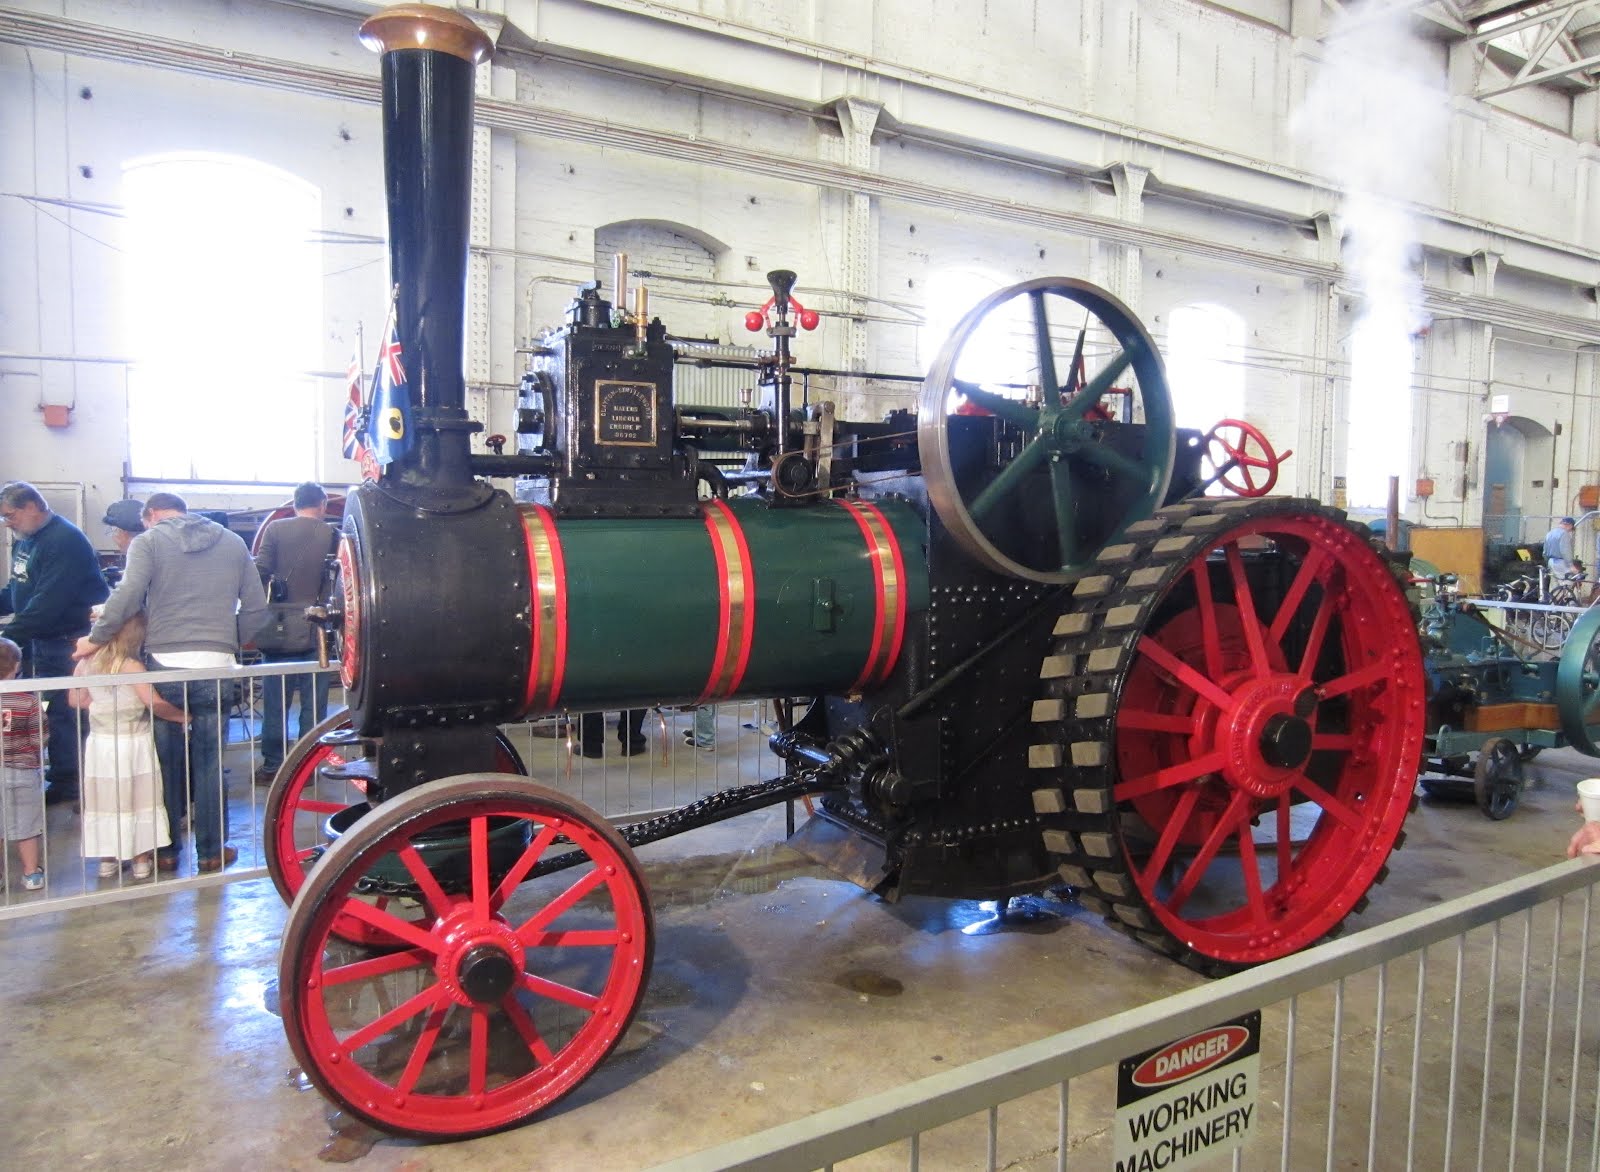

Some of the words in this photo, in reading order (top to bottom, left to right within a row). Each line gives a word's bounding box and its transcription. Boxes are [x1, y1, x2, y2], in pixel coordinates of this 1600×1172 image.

[600, 391, 617, 417] CLAYTON
[1155, 1033, 1229, 1078] DANGER
[1128, 1072, 1246, 1143] WORKING
[1115, 1103, 1254, 1172] MACHINERY
